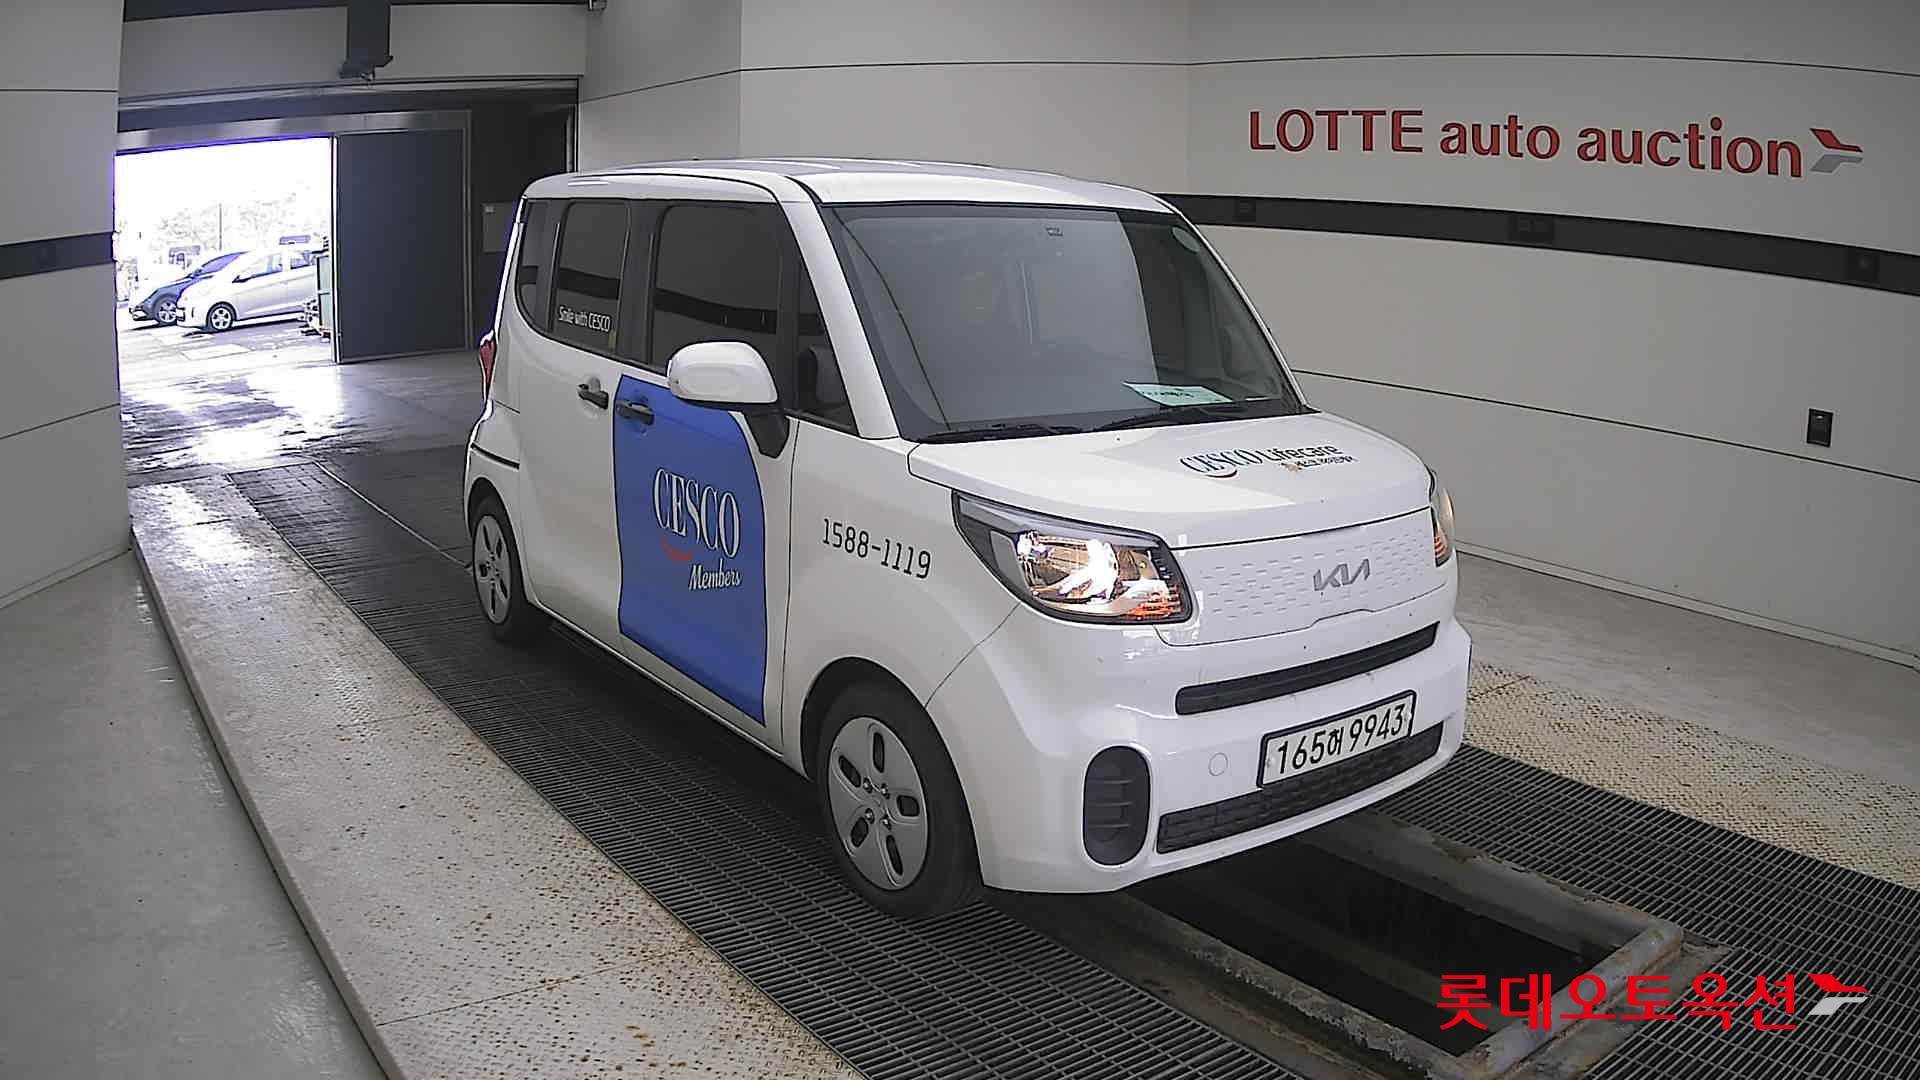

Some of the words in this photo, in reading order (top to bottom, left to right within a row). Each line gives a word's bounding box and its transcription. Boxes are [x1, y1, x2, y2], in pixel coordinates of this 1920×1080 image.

[1248, 109, 1424, 153] LOTTE
[1440, 114, 1560, 160] auto
[1576, 117, 1804, 178] auction
[588, 312, 611, 332] CESCO
[1178, 448, 1262, 473] CESCO
[1262, 444, 1344, 463] Lifecare
[653, 467, 741, 559] CESCO
[821, 517, 932, 580] 1588-1119
[687, 558, 742, 592] Members
[1312, 558, 1371, 592] KIA
